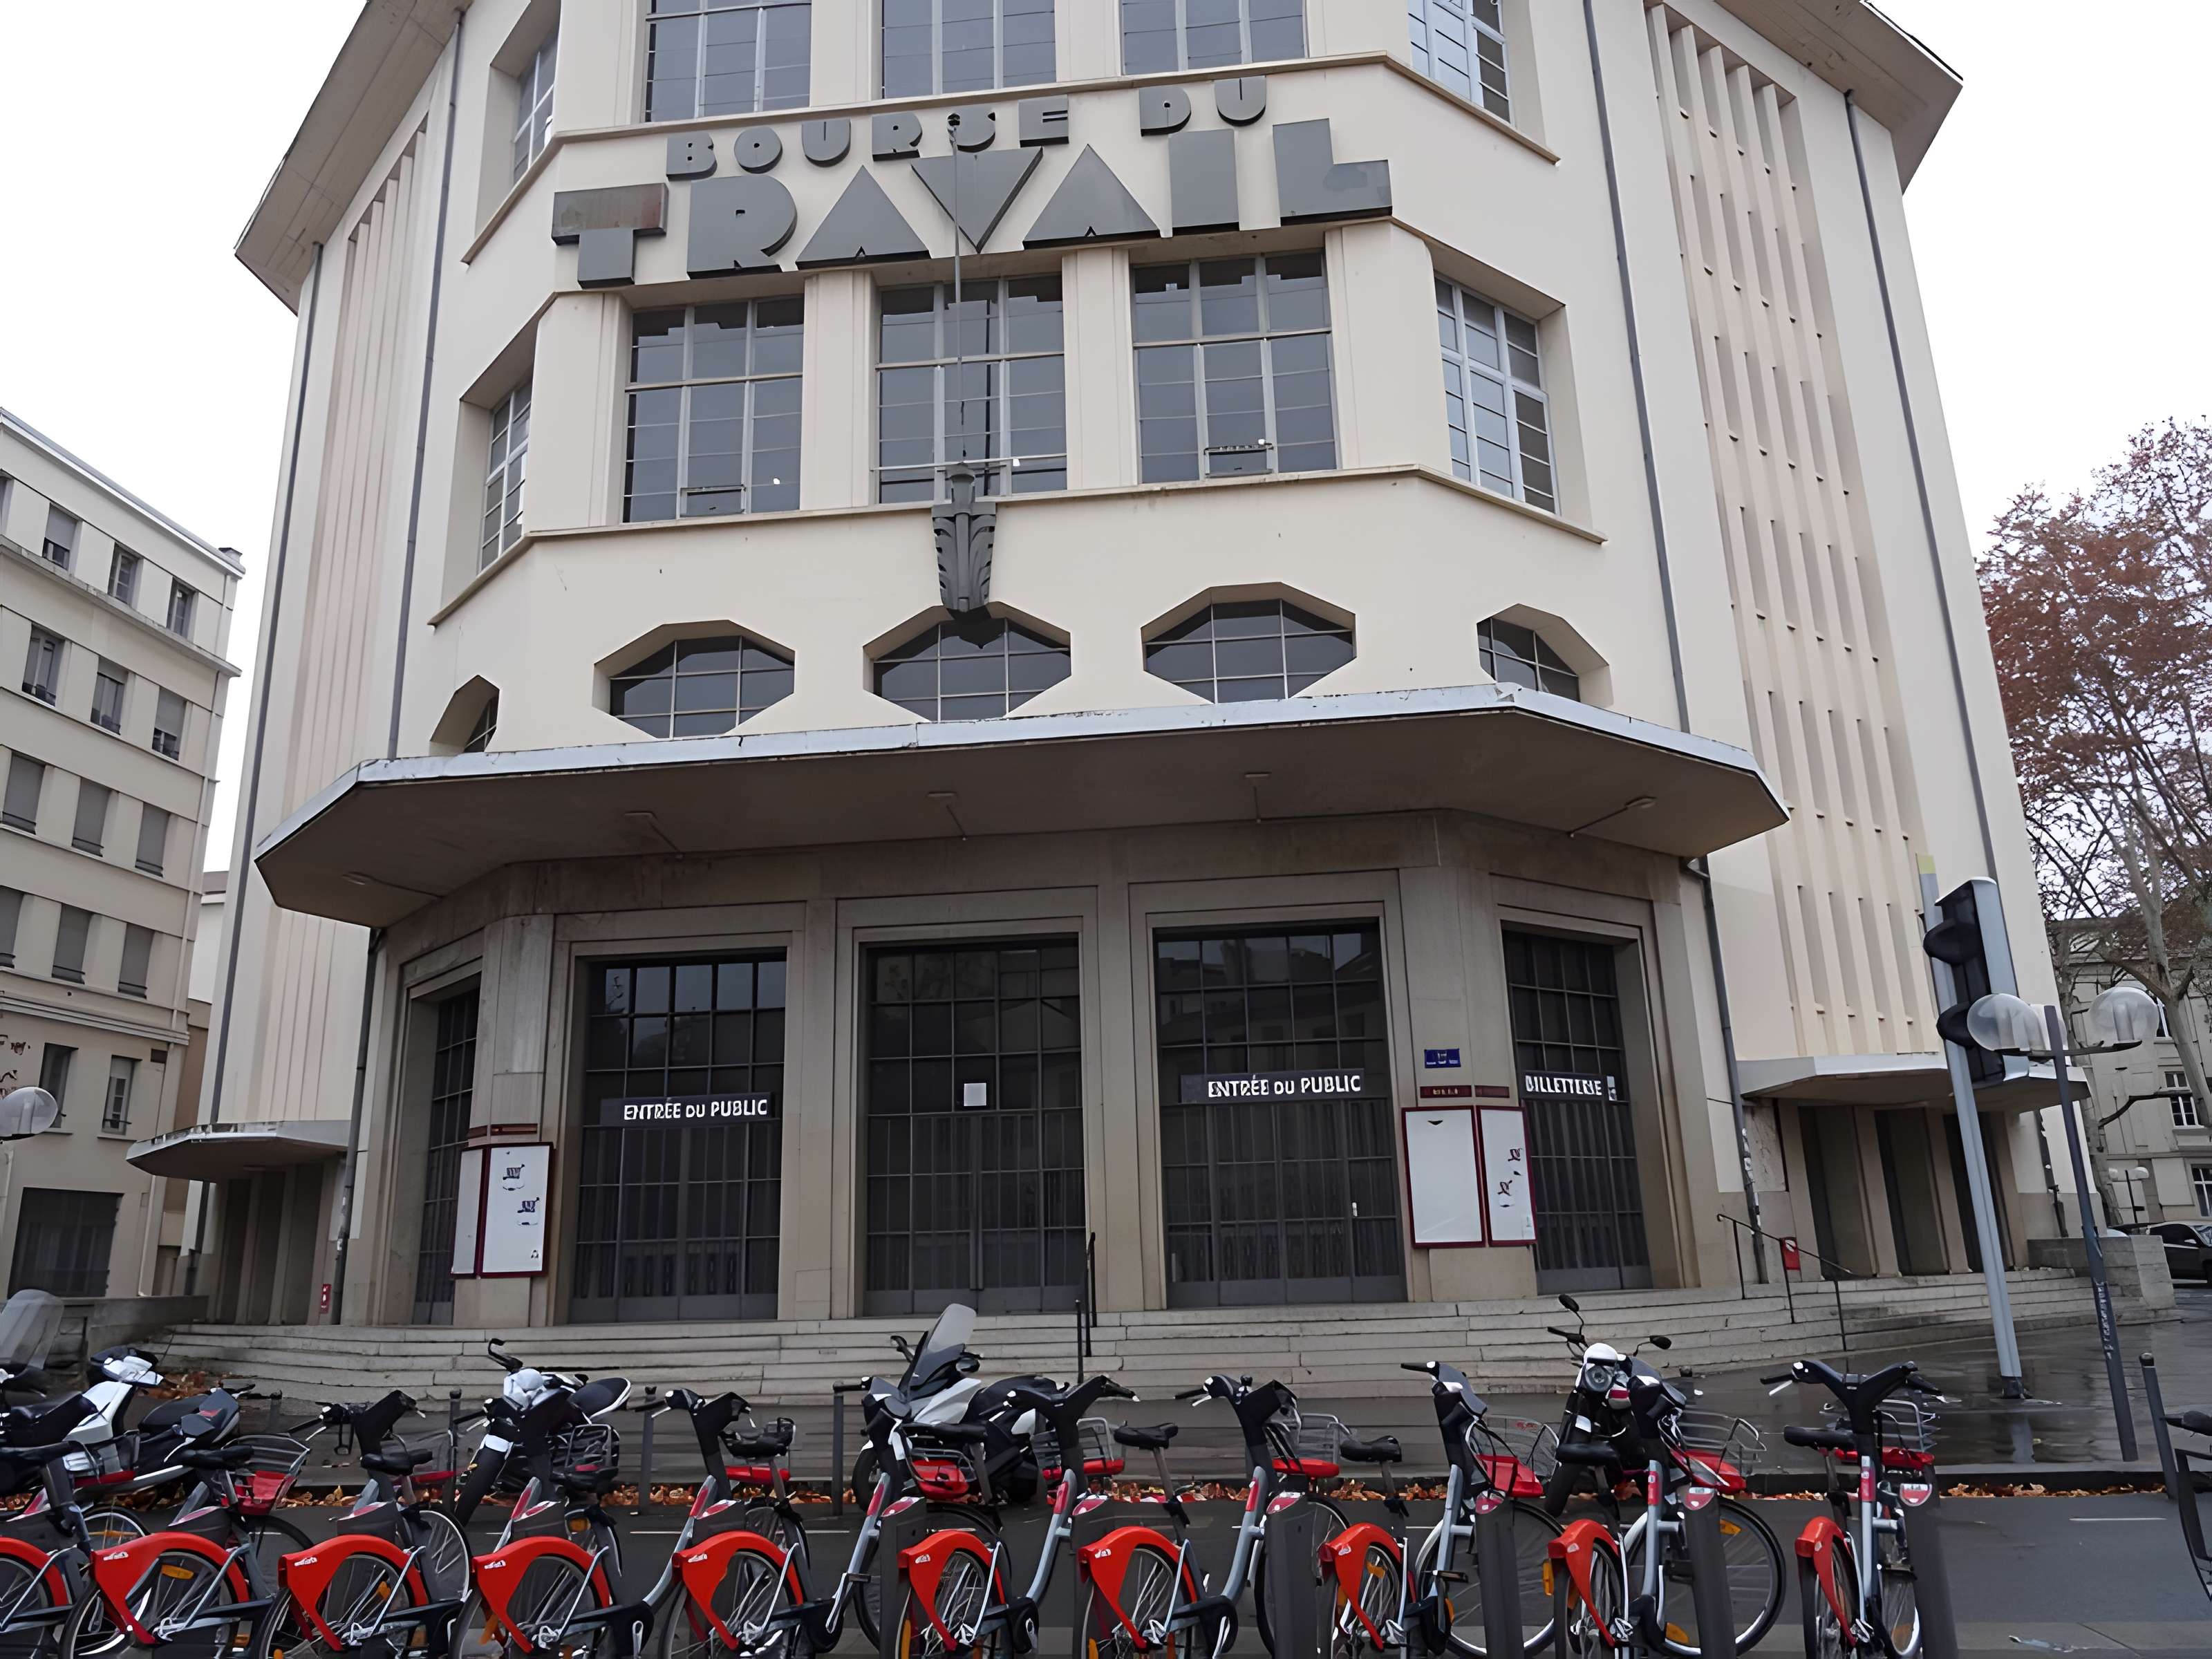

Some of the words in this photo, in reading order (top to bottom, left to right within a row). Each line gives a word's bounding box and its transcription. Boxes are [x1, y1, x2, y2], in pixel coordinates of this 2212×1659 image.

[666, 93, 1070, 181] BOURSE
[1139, 74, 1267, 138] DU
[552, 118, 1393, 289] TRAVAIL
[685, 1103, 706, 1118] DU
[710, 1099, 768, 1117] PUBLIC
[1274, 1080, 1295, 1095] DU
[1300, 1075, 1362, 1094] PUBLIC
